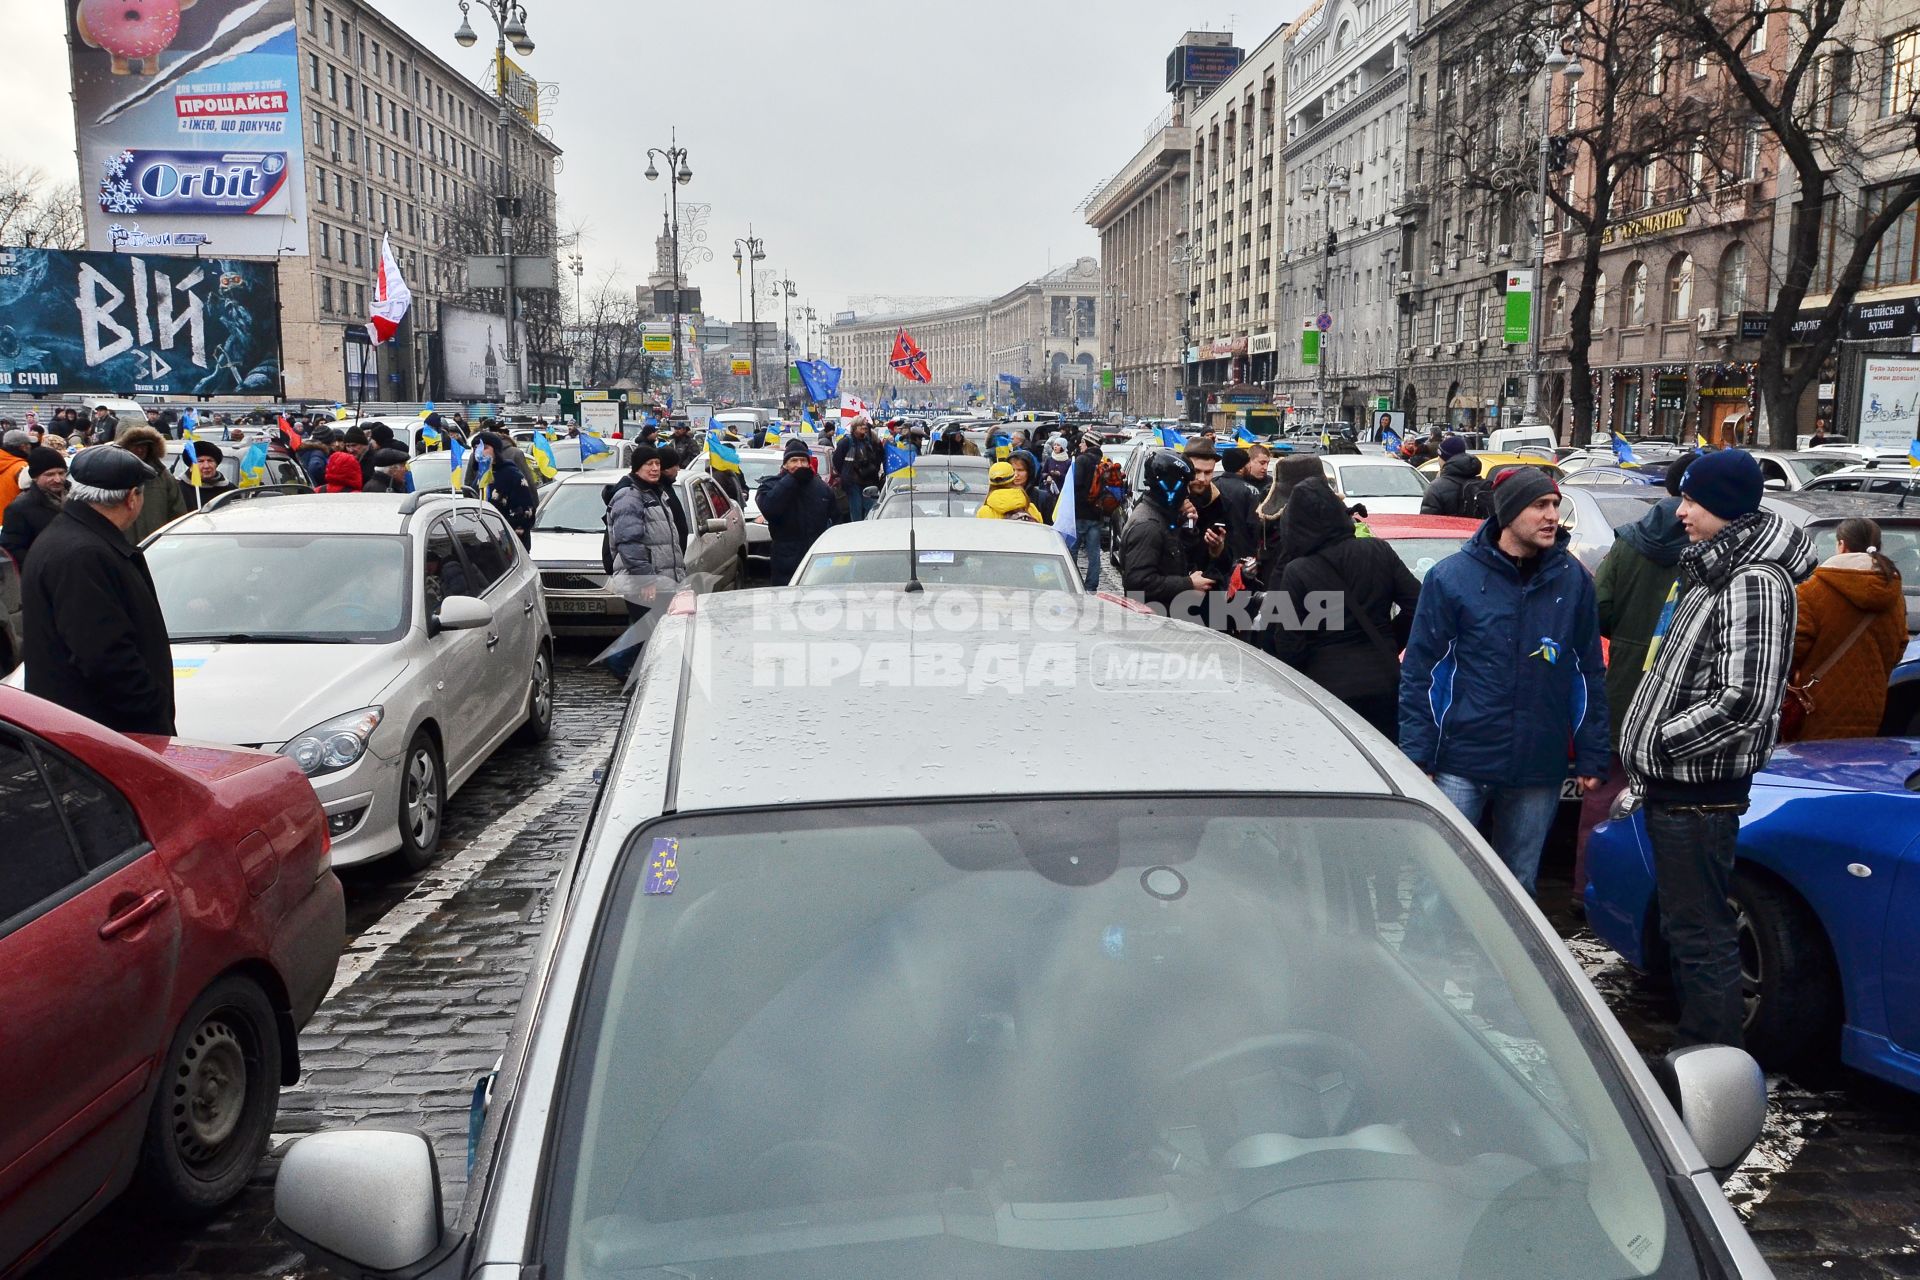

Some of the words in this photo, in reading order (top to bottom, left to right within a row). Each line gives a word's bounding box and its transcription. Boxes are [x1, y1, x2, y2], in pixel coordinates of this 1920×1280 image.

[179, 94, 283, 112] ПРОЩАЙСЯ
[189, 118, 217, 132] ЇЖЕЮ,
[221, 120, 236, 132] ЩО
[239, 120, 282, 132] ДОКУЧАЄ
[142, 163, 261, 199] Orbit
[75, 256, 208, 369] ВІЙ
[1860, 304, 1905, 319] італійська
[1868, 320, 1894, 334] кухня
[130, 349, 172, 380] 3D
[18, 372, 58, 385] СІЧНЯ
